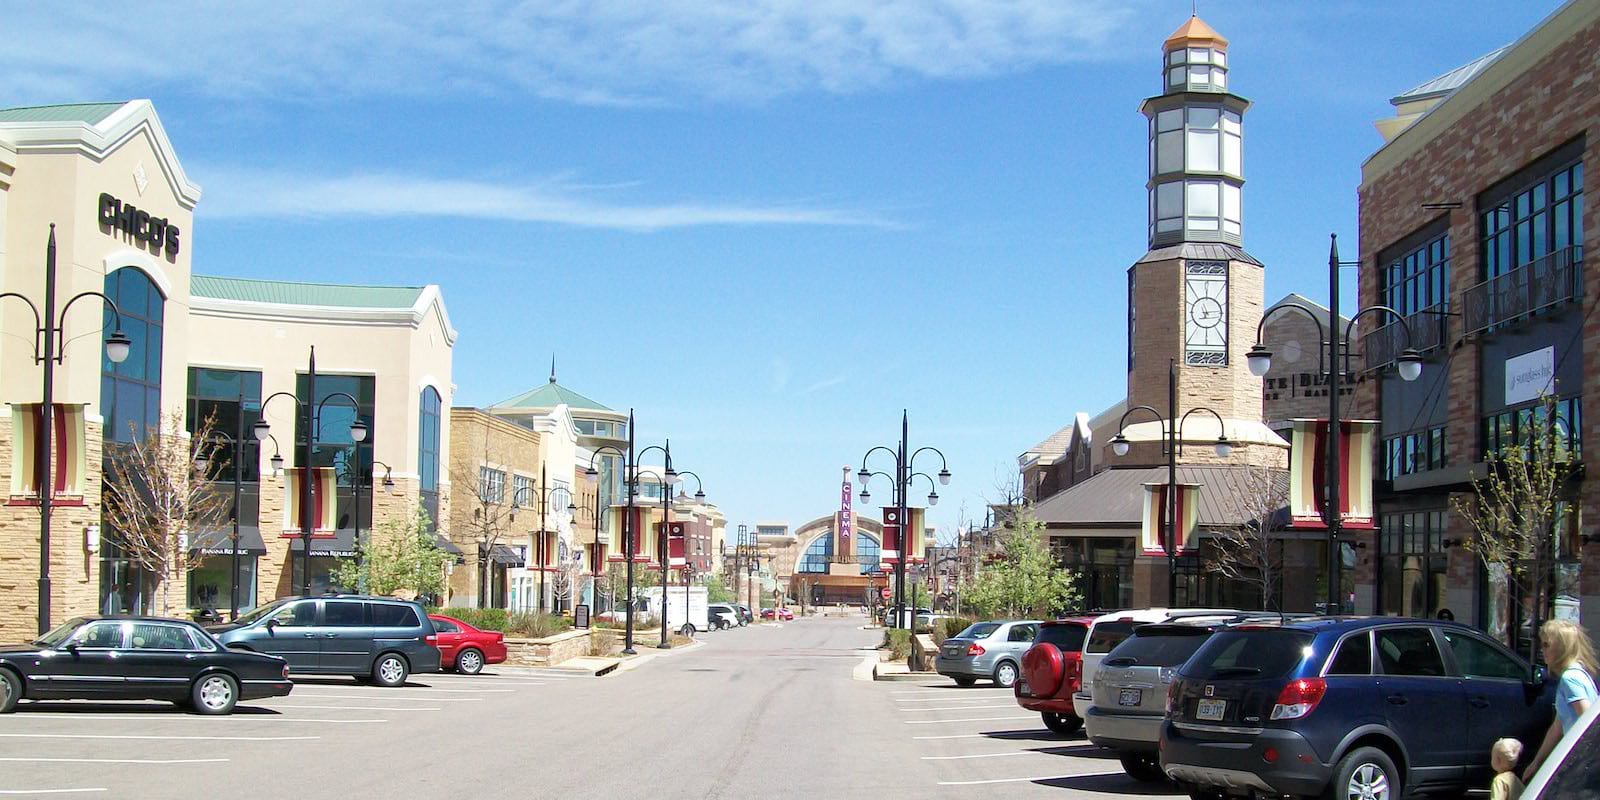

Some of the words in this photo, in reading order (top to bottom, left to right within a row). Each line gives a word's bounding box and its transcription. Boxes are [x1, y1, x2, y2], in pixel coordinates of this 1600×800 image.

[99, 193, 180, 255] CHICO'S
[1300, 373, 1356, 387] BLAK
[1304, 388, 1353, 397] MARET
[842, 485, 850, 537] CINEMA
